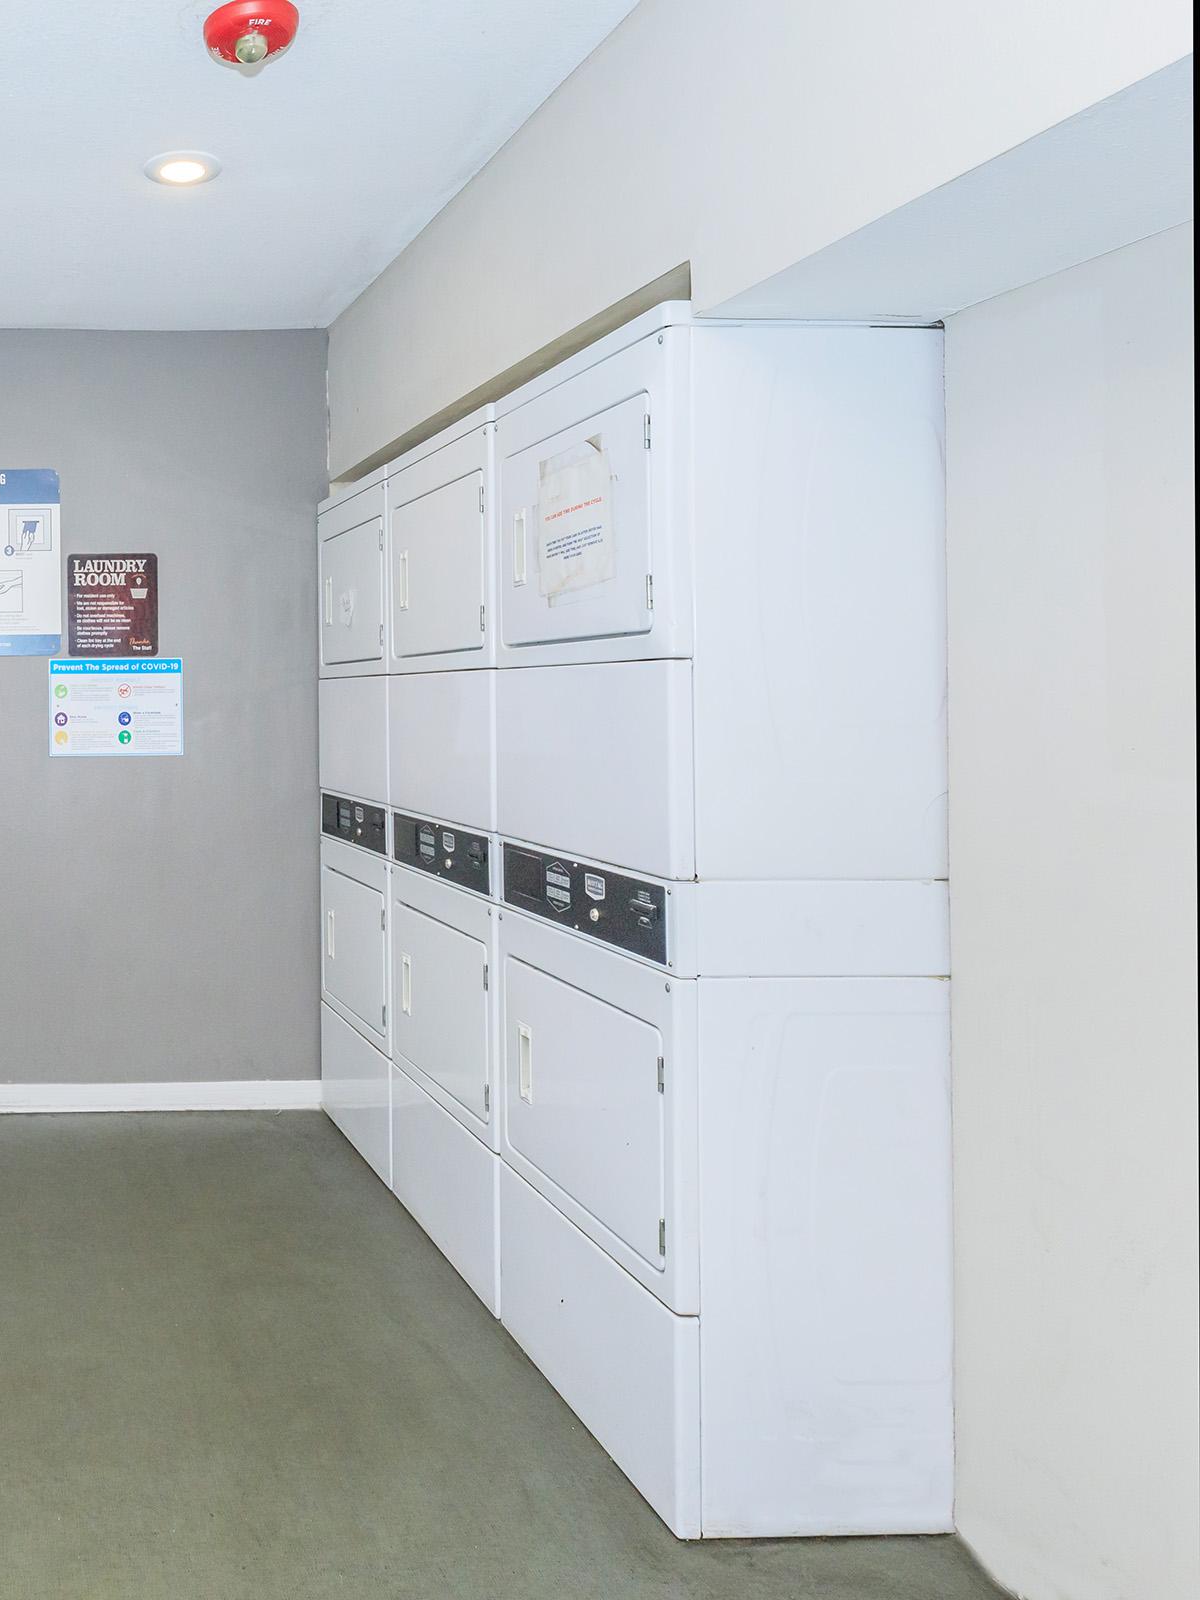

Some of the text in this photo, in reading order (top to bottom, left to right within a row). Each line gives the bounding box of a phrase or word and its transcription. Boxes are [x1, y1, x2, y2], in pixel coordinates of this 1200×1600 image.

[73, 559, 147, 573] LAUNDRY
[73, 573, 127, 586] ROOM
[53, 663, 83, 671] Prevent
[85, 663, 100, 671] The
[102, 663, 128, 672] Spread
[141, 662, 179, 670] COVID-19
